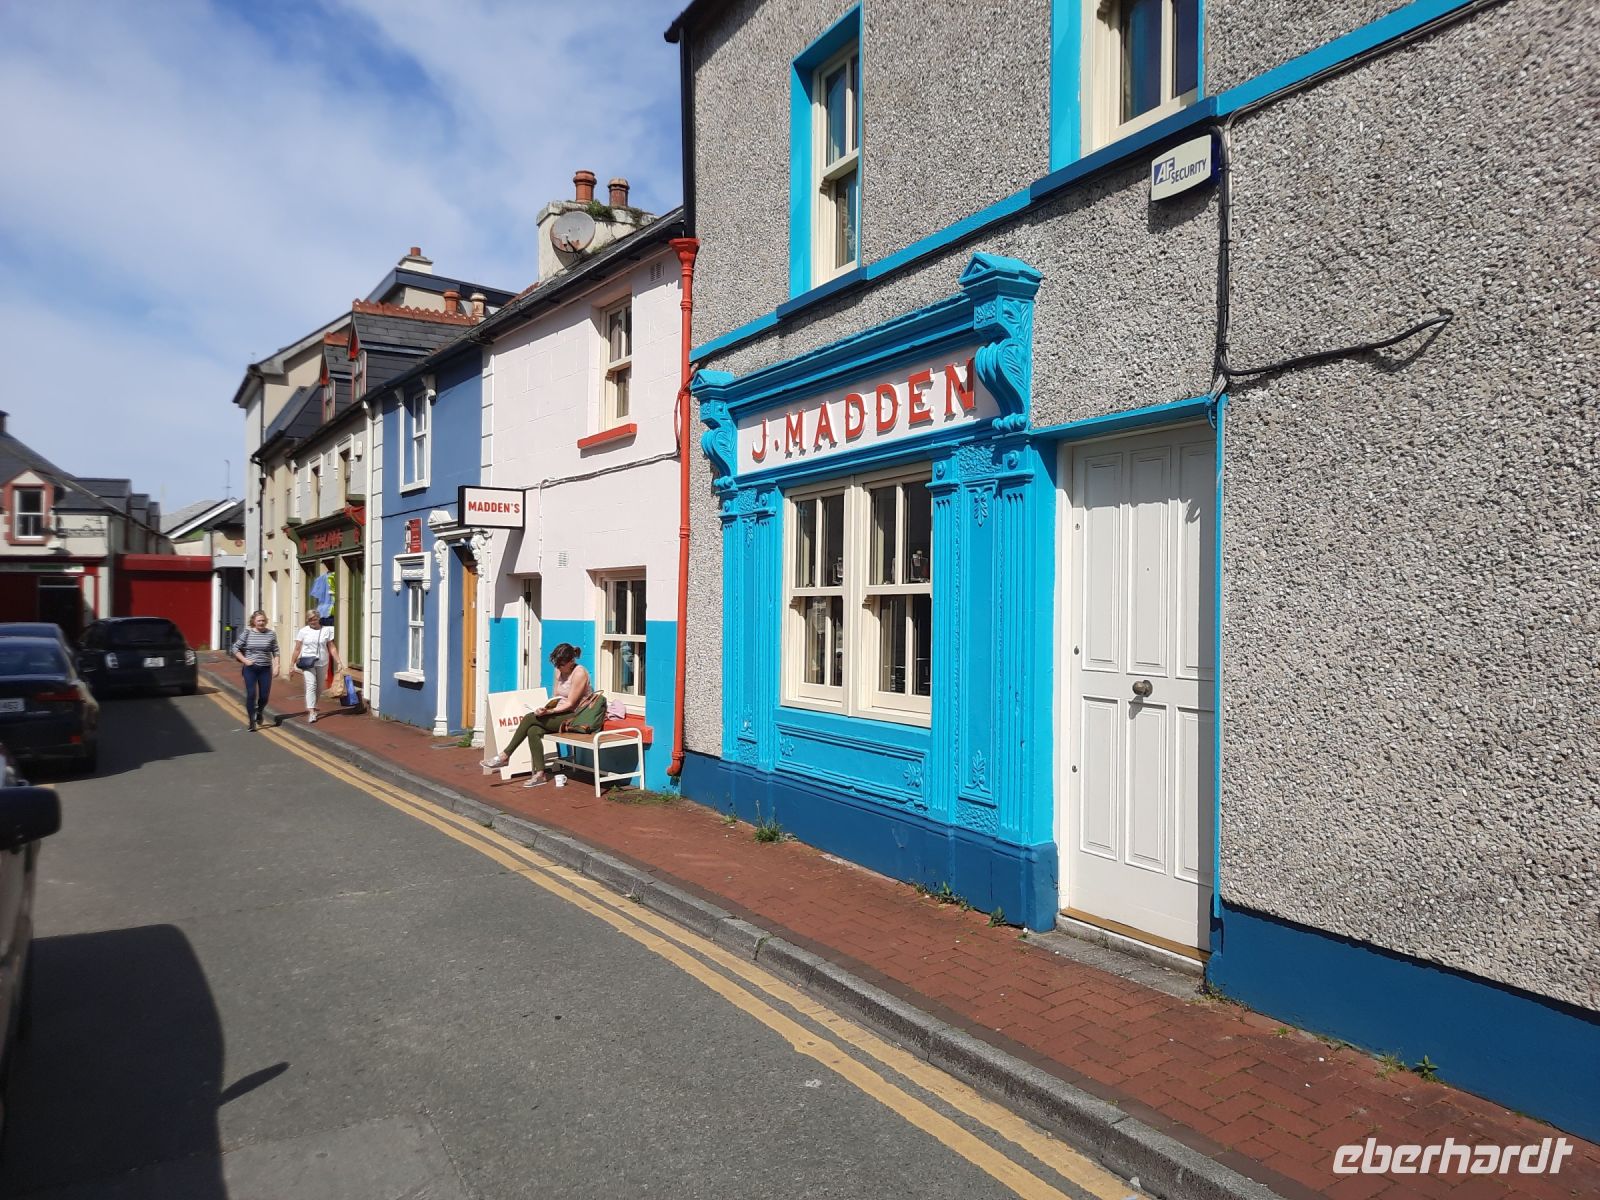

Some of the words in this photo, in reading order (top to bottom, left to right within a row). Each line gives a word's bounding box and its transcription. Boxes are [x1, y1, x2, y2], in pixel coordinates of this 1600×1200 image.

[1154, 157, 1175, 185] AF
[1171, 158, 1207, 184] SECURITY
[468, 501, 520, 514] MADDEN'S
